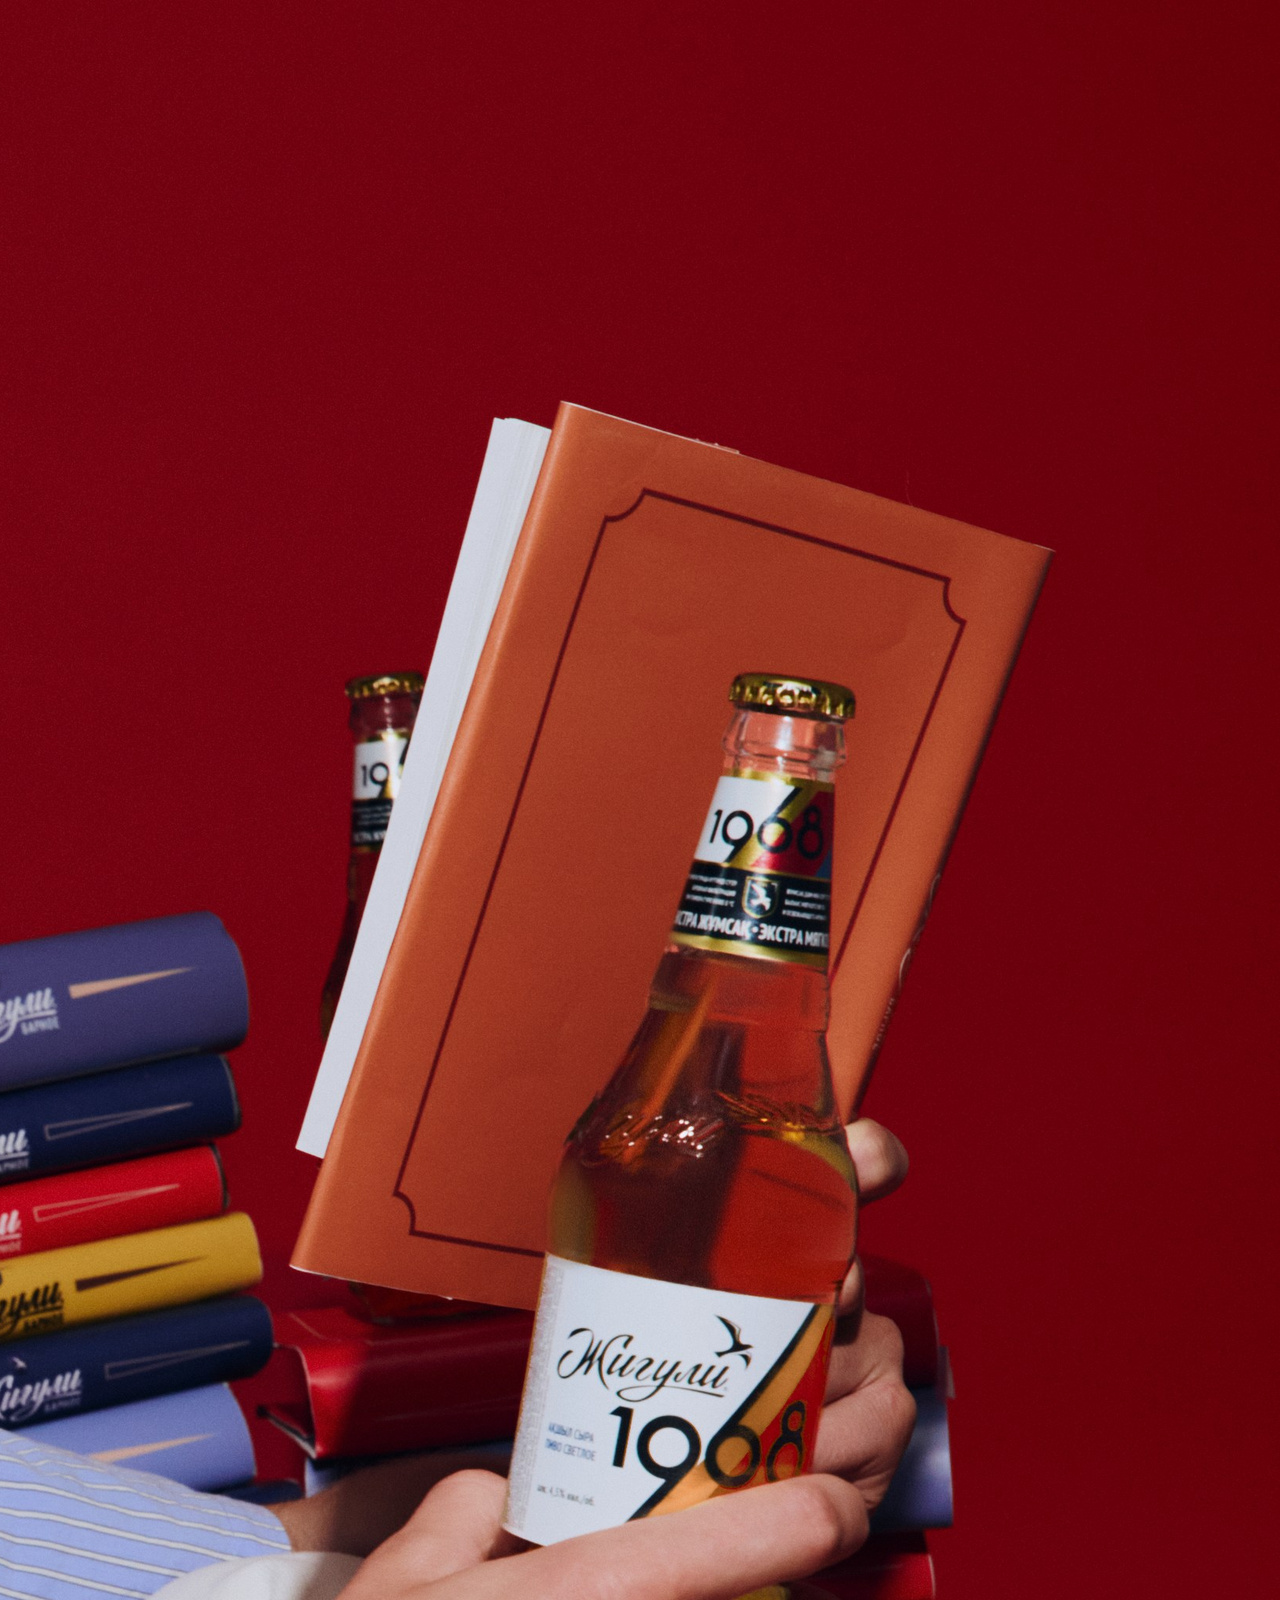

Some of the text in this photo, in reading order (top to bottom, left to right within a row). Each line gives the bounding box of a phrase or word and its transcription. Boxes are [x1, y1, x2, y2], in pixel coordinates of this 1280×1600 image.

[709, 786, 824, 864] 1968
[757, 923, 804, 946] ЭКСТРА
[557, 1327, 730, 1402] Жигули
